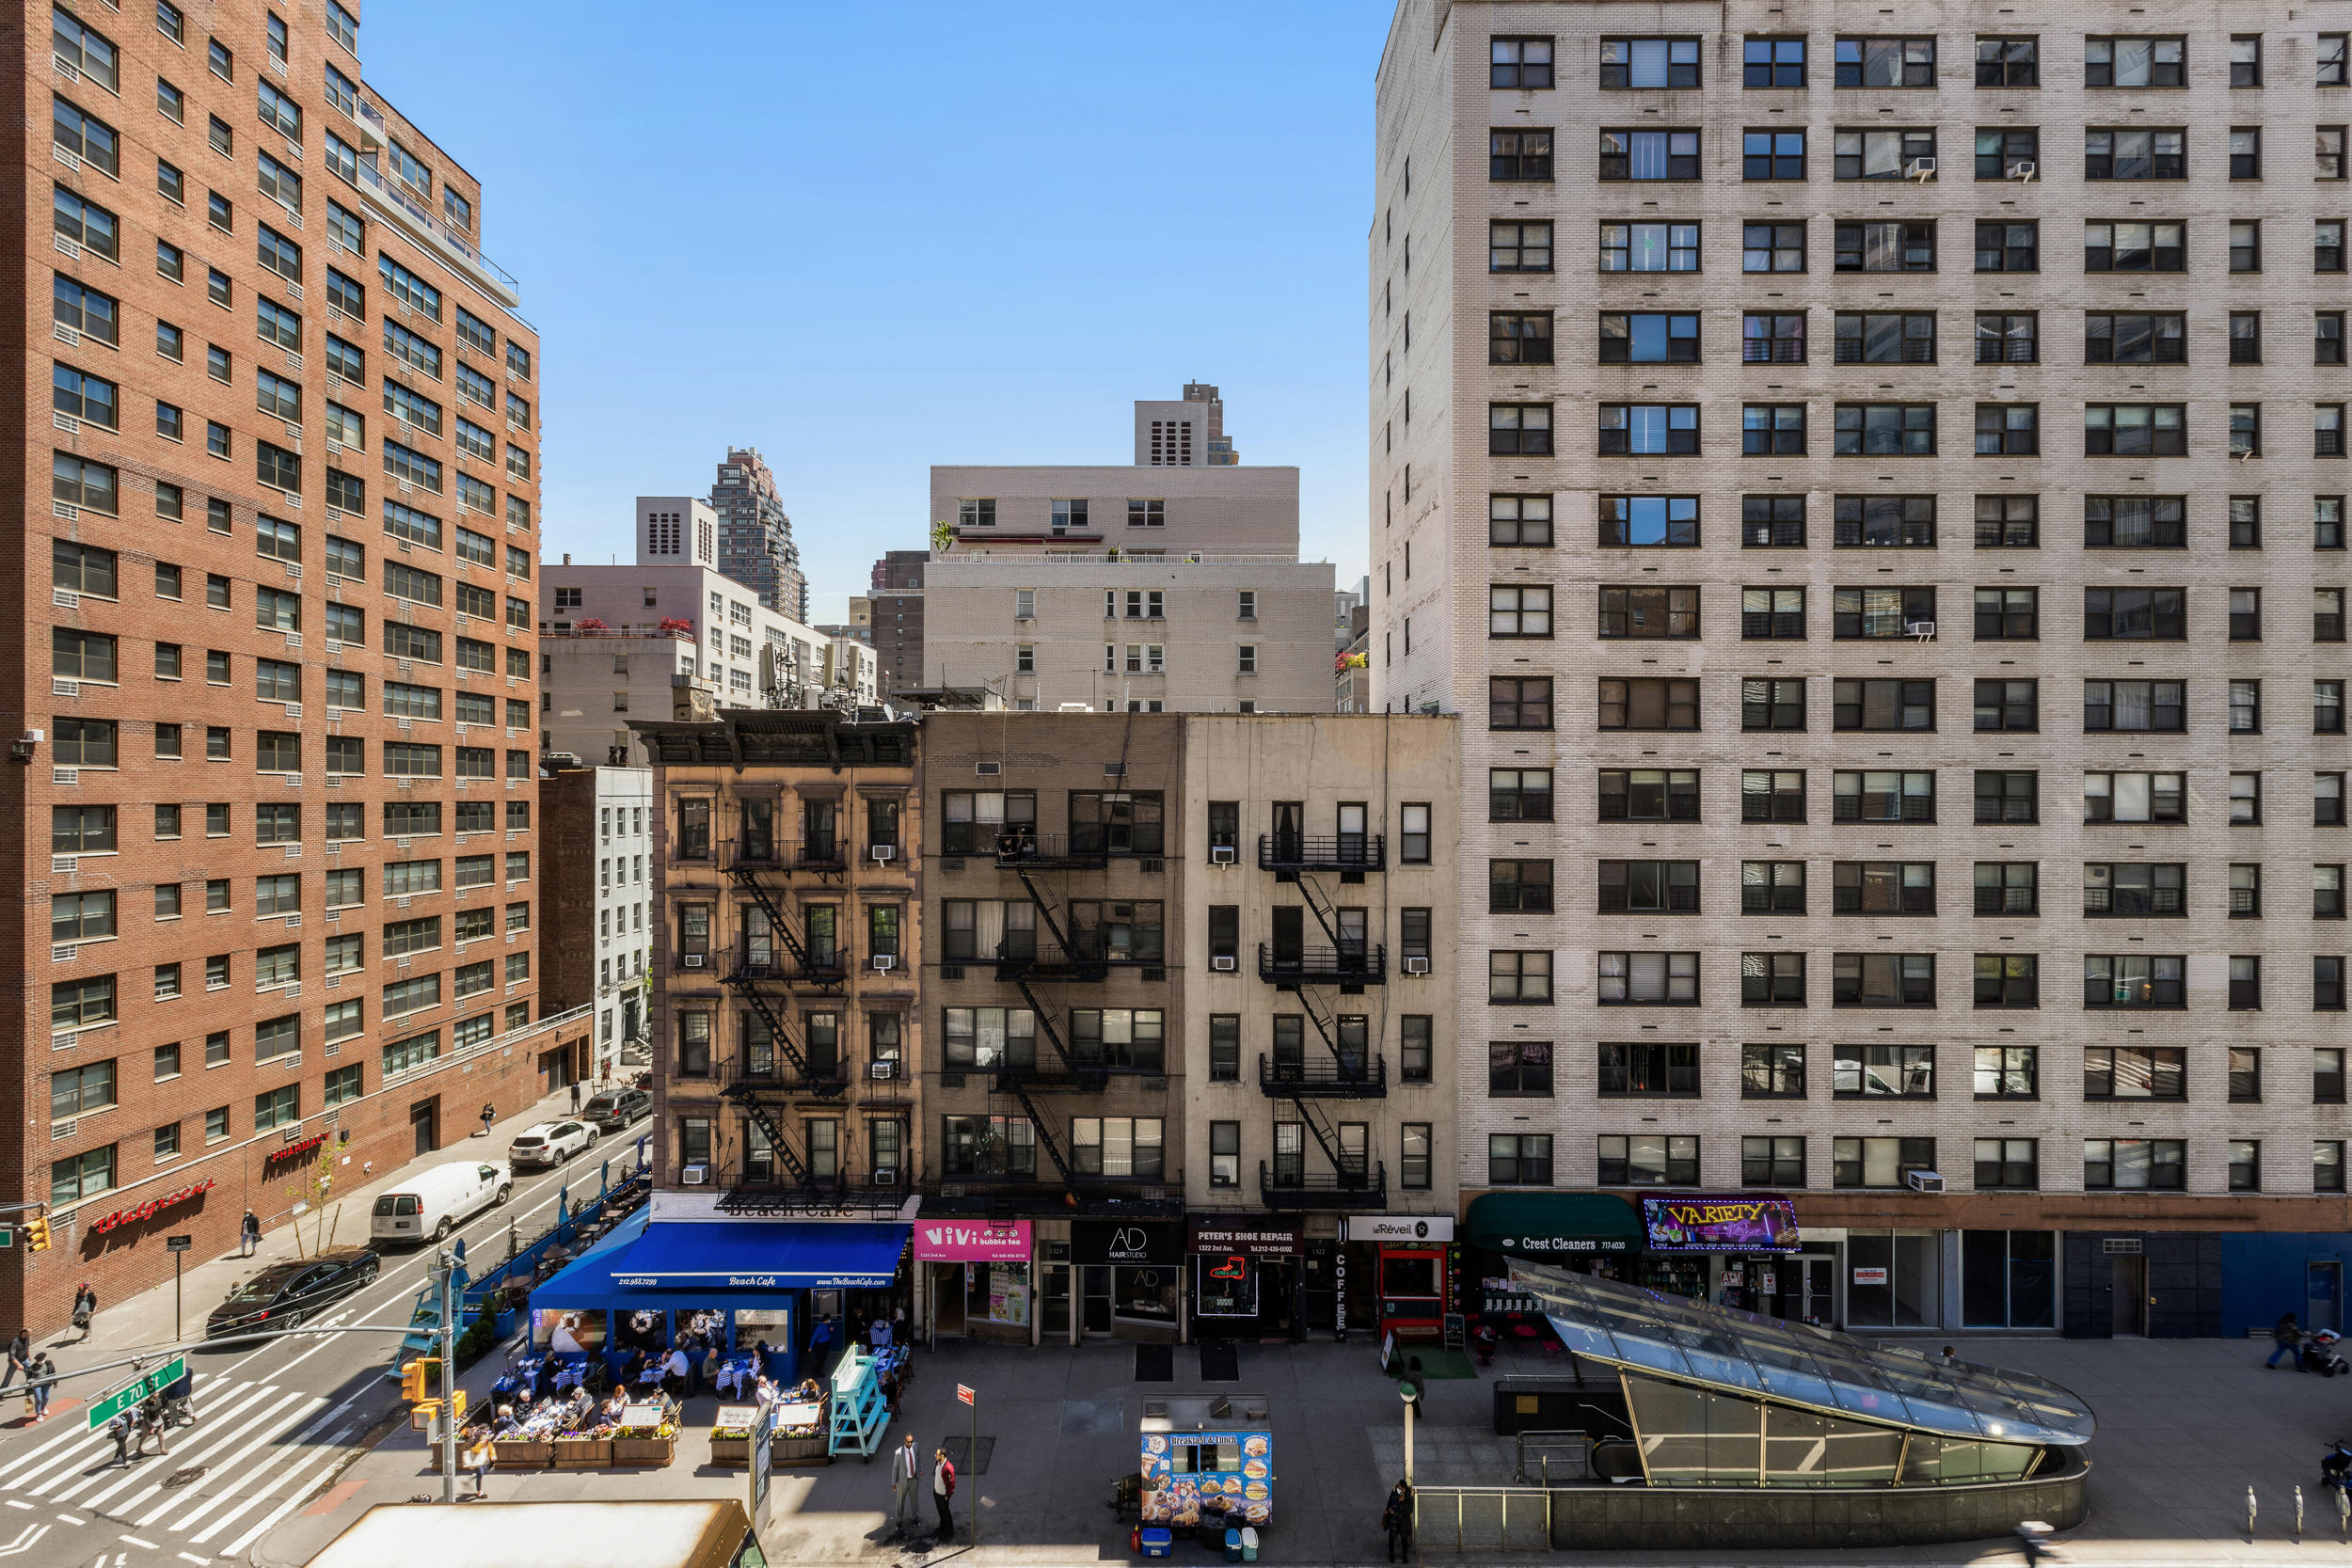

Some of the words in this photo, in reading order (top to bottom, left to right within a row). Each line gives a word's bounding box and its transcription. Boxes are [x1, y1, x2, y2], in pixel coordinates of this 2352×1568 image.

[273, 1131, 330, 1163] PHARMACY
[93, 1178, 217, 1234] Walgreens
[1667, 1203, 1766, 1226] VARIETY
[925, 1227, 977, 1245] ViVi
[1109, 1227, 1147, 1251] AD
[1198, 1231, 1232, 1241] PETER'S
[1234, 1231, 1258, 1241] SHOE
[1261, 1232, 1294, 1242] REPAIR
[1714, 1219, 1765, 1243] Vape
[1522, 1237, 1549, 1250] Crest
[1552, 1237, 1597, 1250] Cleaners
[1601, 1241, 1626, 1250] 717-6030
[618, 1277, 658, 1286] 212.988.7299
[729, 1275, 755, 1286] Beach
[756, 1275, 776, 1287] Cafe
[817, 1276, 886, 1287] www.TheBeachCafe.com
[1133, 1269, 1159, 1287] AD
[1722, 1272, 1742, 1283] ATM
[1336, 1254, 1346, 1326] COFFEE
[117, 1394, 125, 1410] E
[129, 1384, 144, 1402] 70
[148, 1375, 160, 1392] St
[1171, 1435, 1206, 1445] Breakfast
[1207, 1435, 1214, 1445] &
[1216, 1435, 1237, 1444] Lunch
